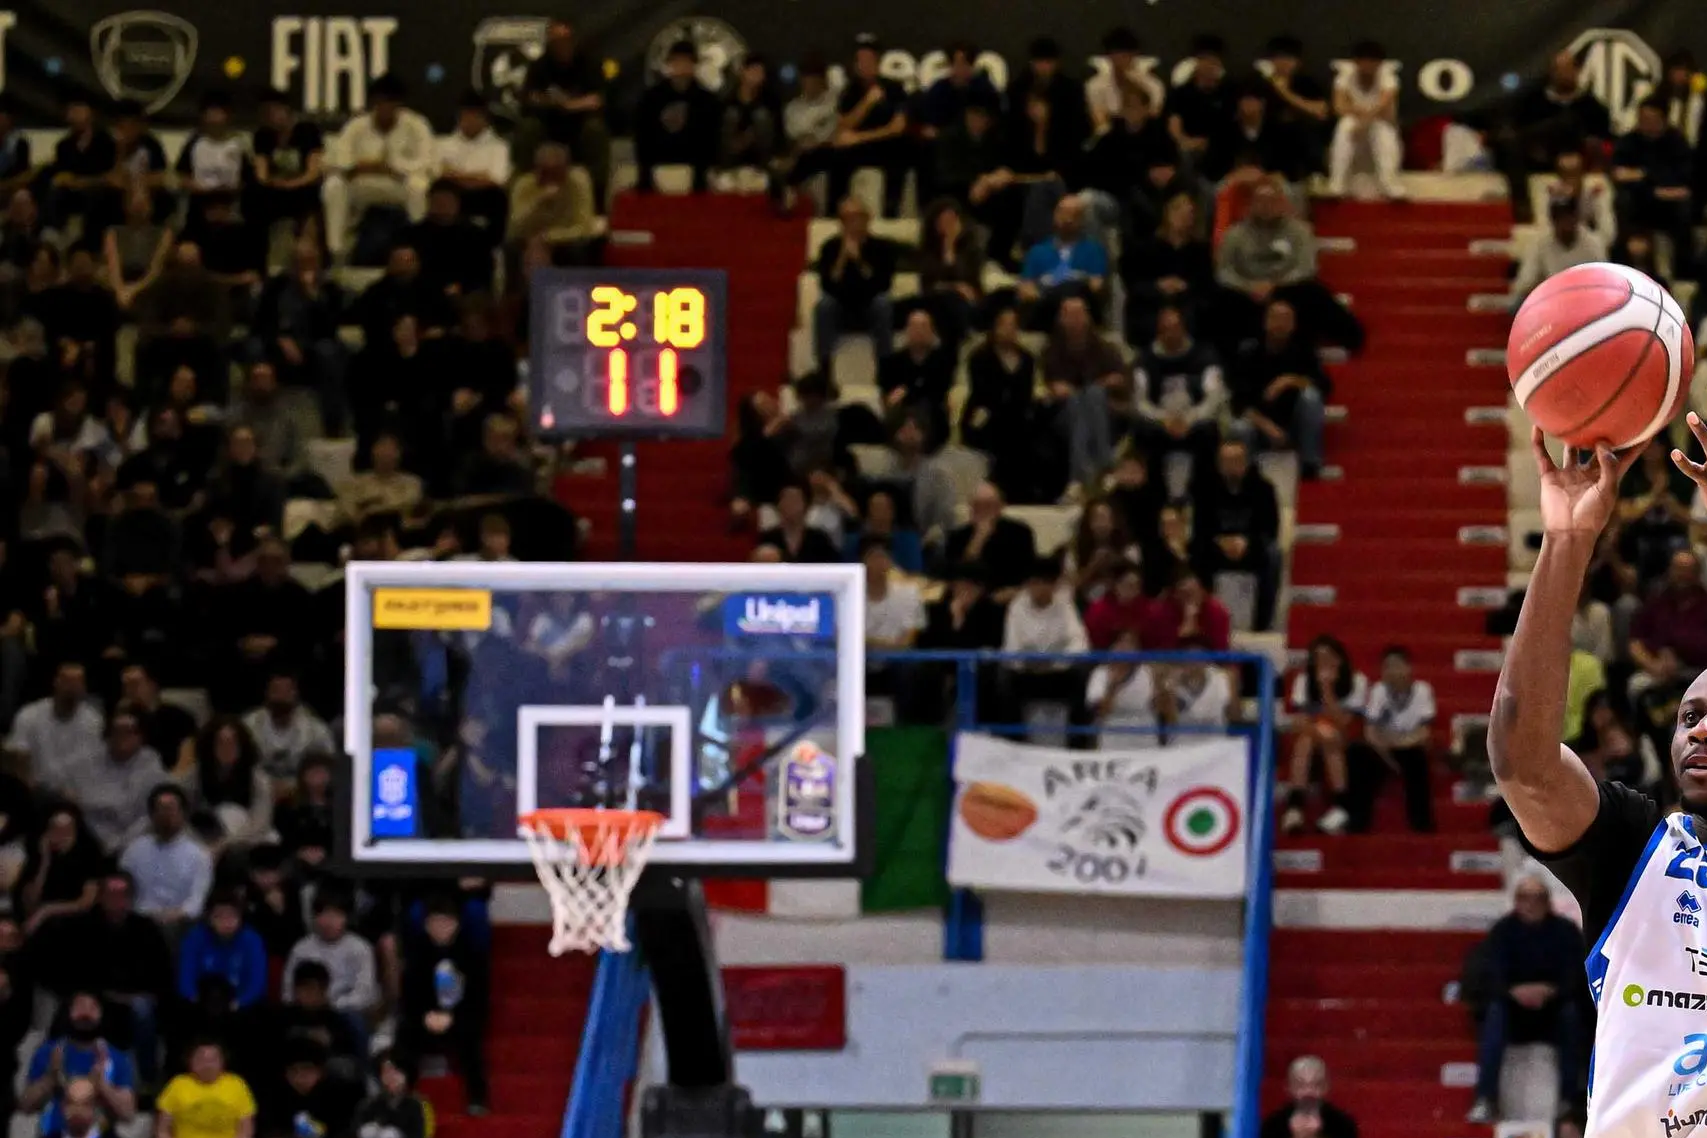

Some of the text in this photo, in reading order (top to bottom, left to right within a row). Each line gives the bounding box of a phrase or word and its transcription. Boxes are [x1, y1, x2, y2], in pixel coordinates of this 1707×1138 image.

[271, 18, 397, 112] FIAT
[586, 286, 704, 348] 2:18
[608, 348, 677, 416] 11
